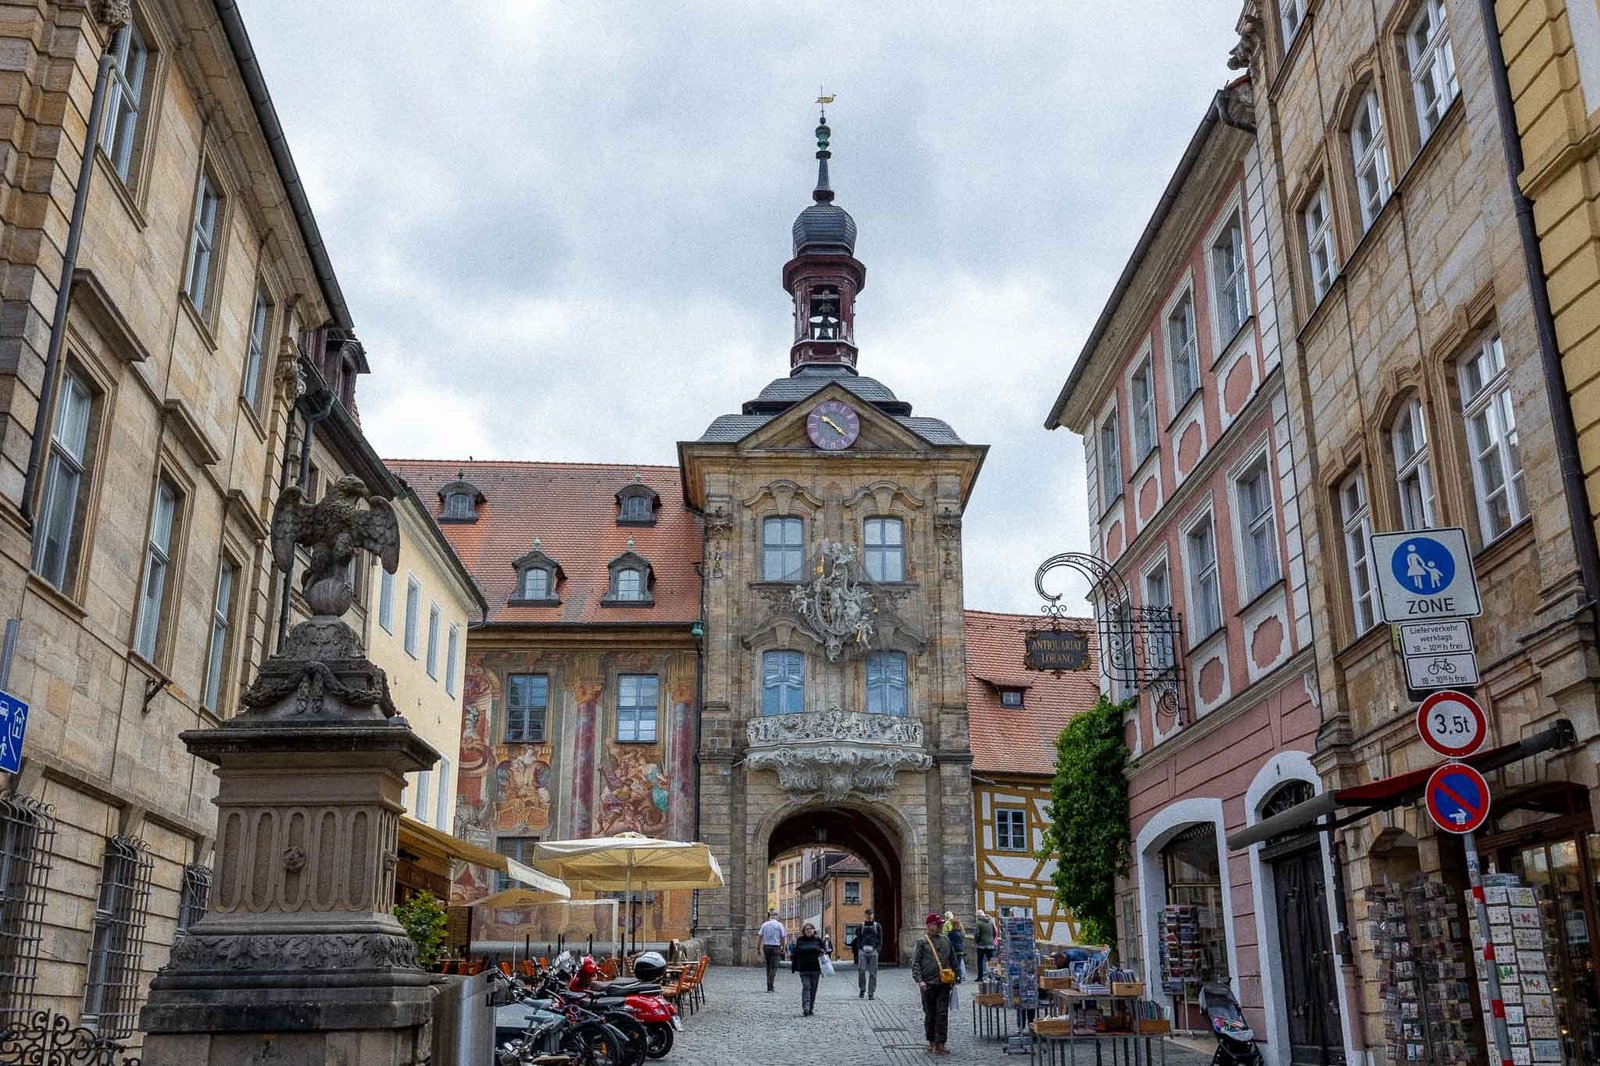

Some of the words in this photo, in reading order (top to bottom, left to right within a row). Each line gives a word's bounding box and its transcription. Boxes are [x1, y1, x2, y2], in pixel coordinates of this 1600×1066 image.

[1407, 598, 1455, 614] ZONE
[1409, 624, 1458, 635] Lieferverkehr
[1419, 634, 1453, 643] werktags
[1413, 645, 1421, 653] 18
[1421, 676, 1429, 685] 18
[1434, 713, 1471, 735] 3,5t
